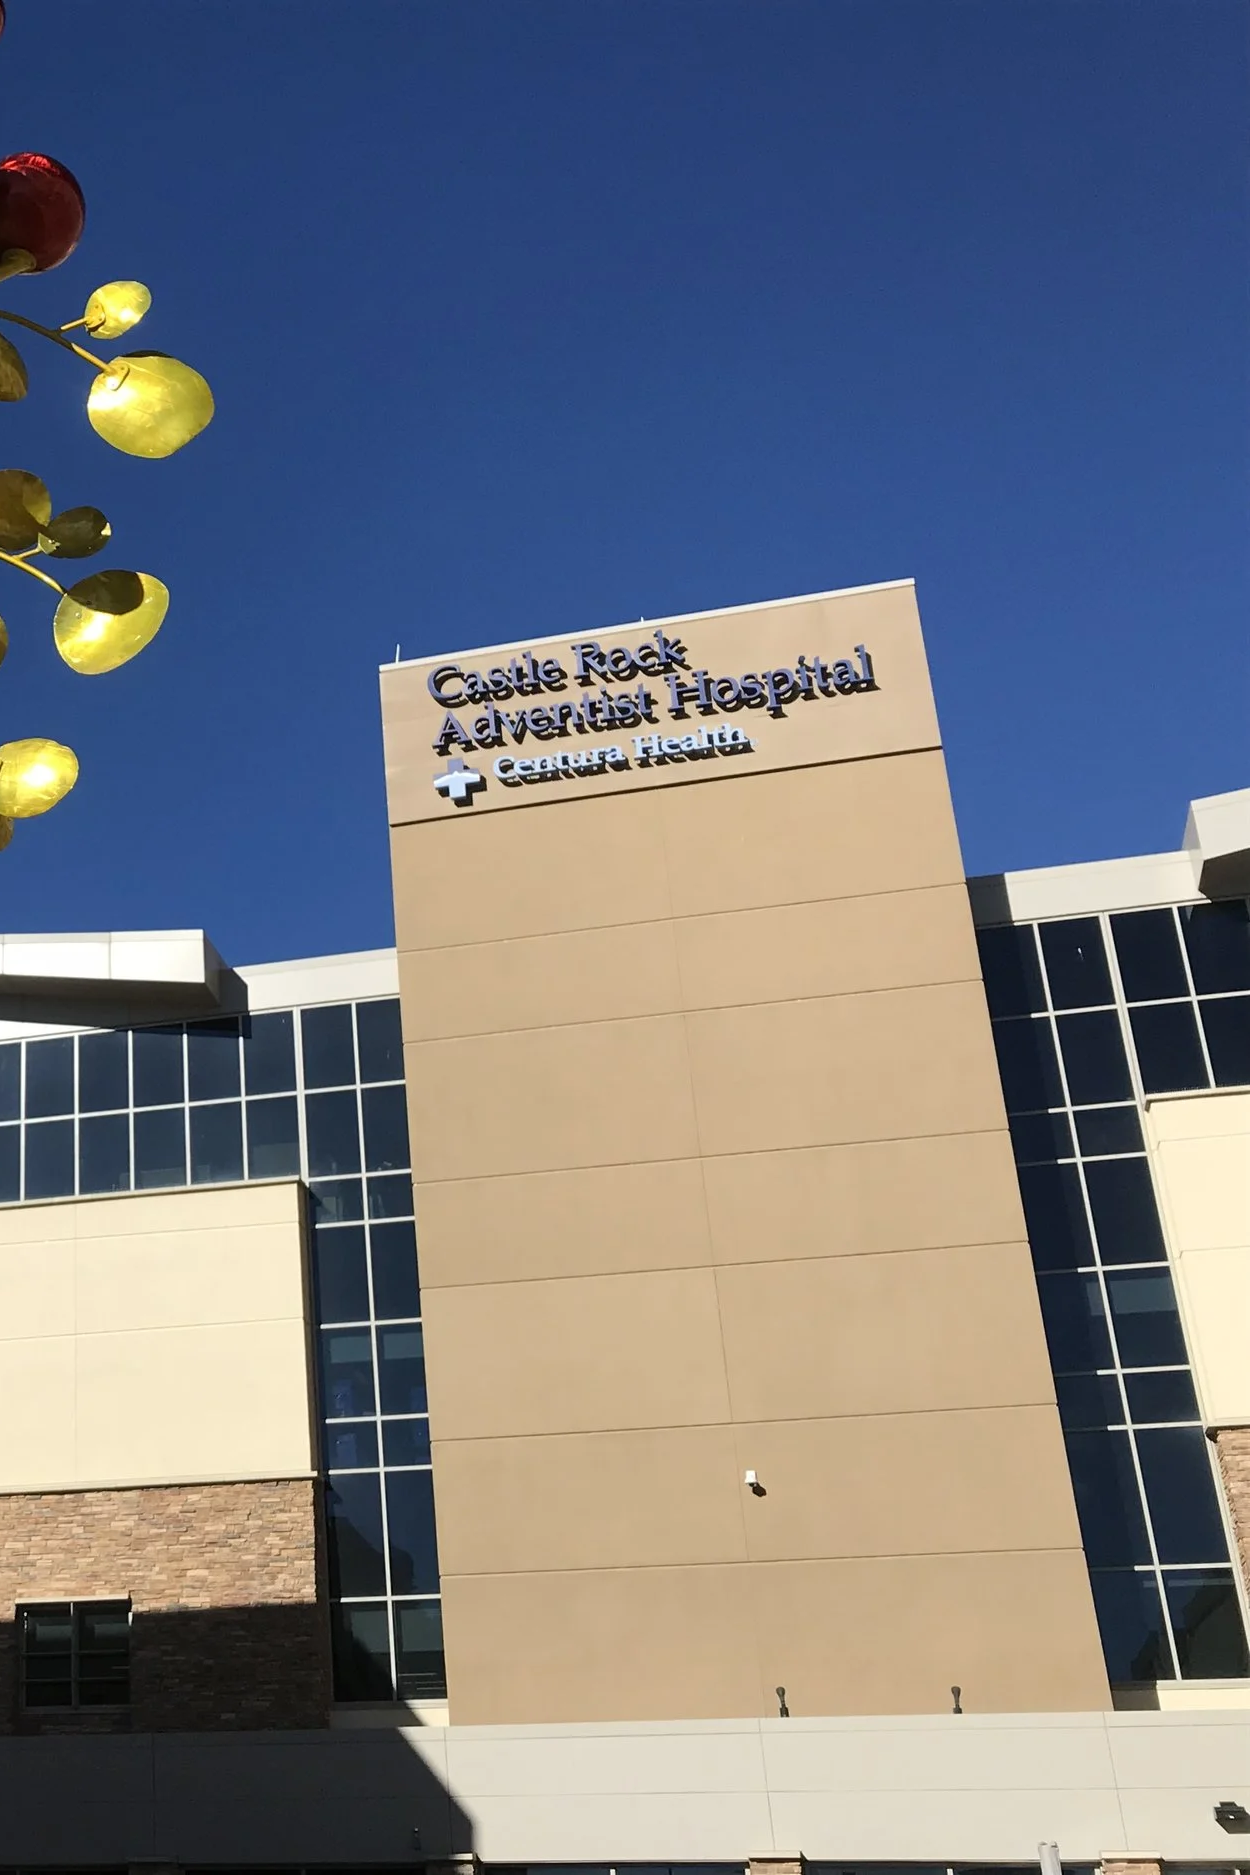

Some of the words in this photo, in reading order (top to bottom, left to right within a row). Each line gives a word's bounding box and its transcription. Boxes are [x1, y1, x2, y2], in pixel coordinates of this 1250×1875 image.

[427, 651, 562, 702] Castle
[571, 629, 686, 679] Rock
[432, 683, 654, 749] Adventist
[664, 644, 875, 711] Hospital
[493, 746, 625, 779] Centura
[632, 722, 750, 759] Health
